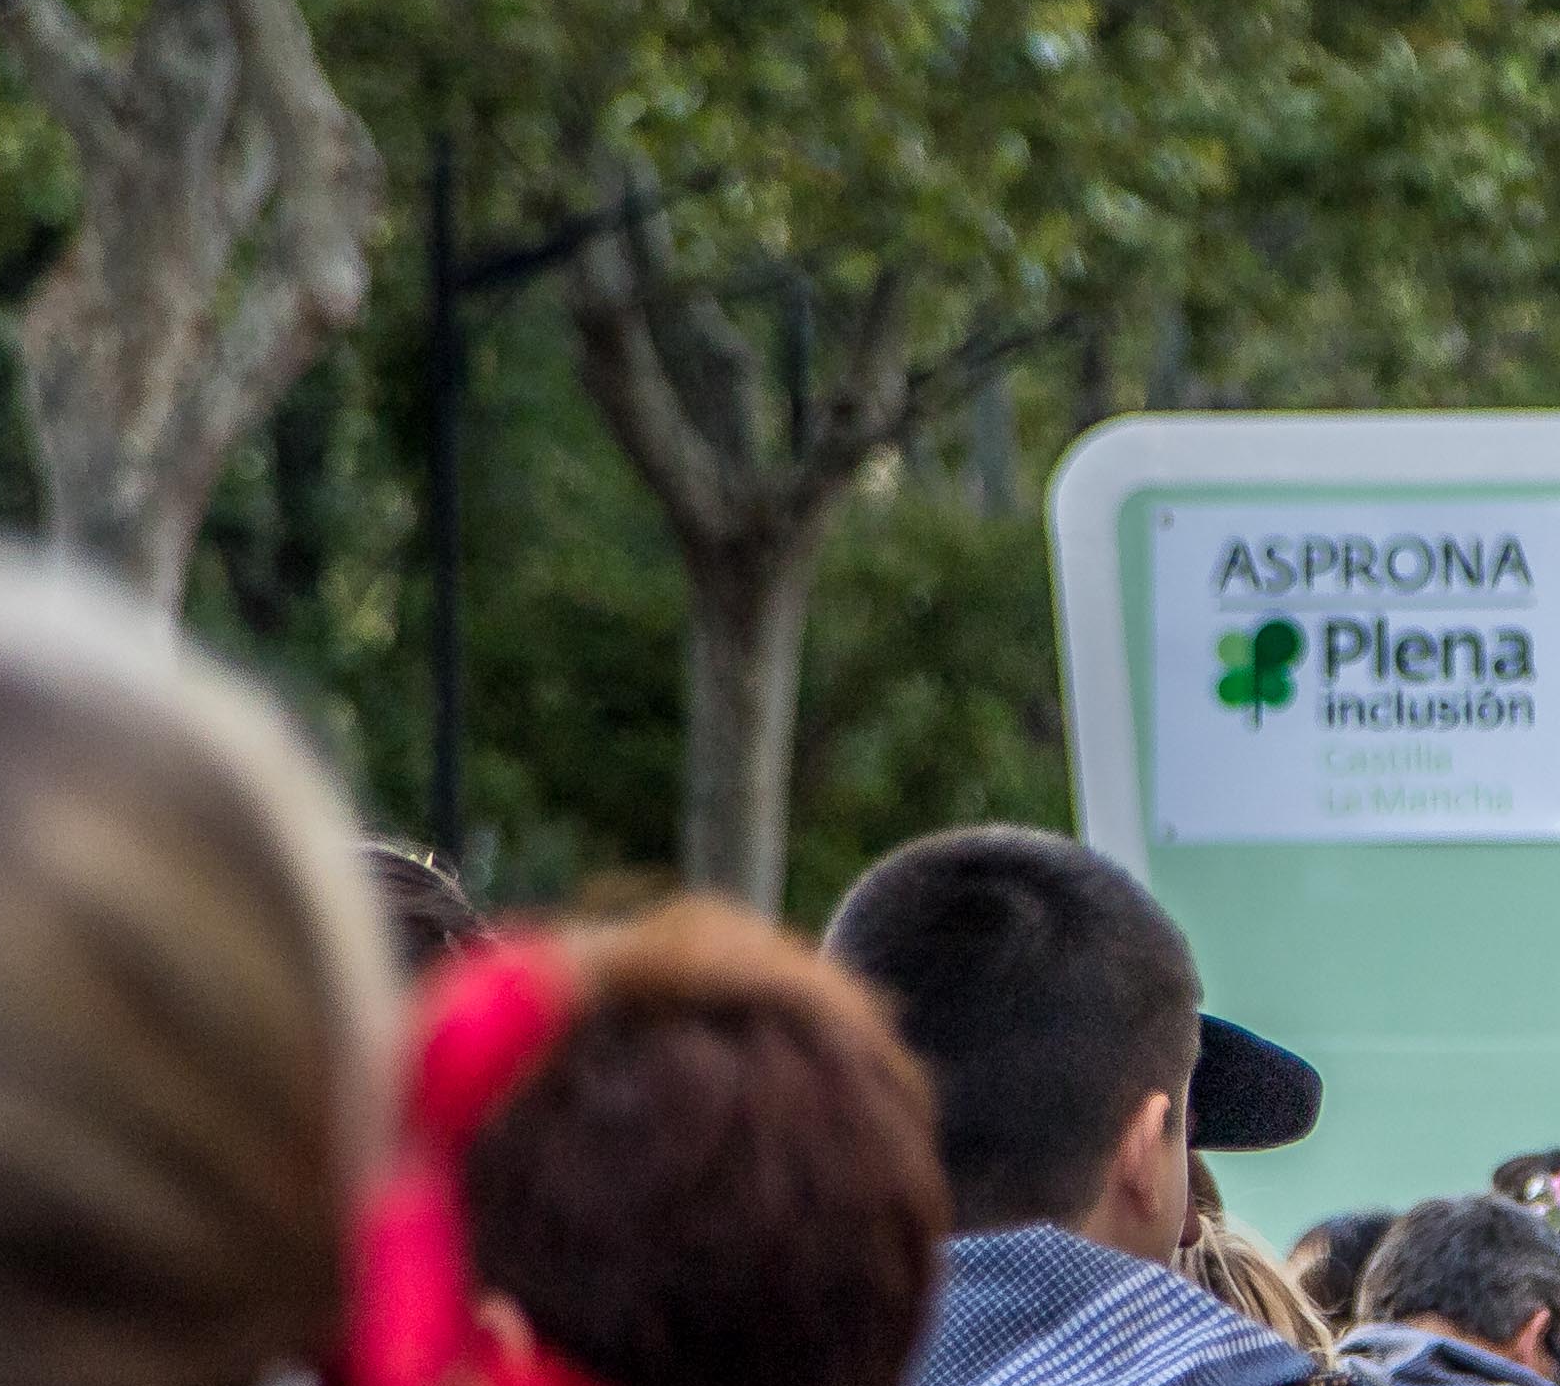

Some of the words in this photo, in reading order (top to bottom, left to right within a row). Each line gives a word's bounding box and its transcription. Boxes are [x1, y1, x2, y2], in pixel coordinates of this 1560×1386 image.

[1216, 534, 1534, 594] ASPRONA
[1324, 616, 1535, 682] Plena
[1324, 688, 1536, 729] inclusión
